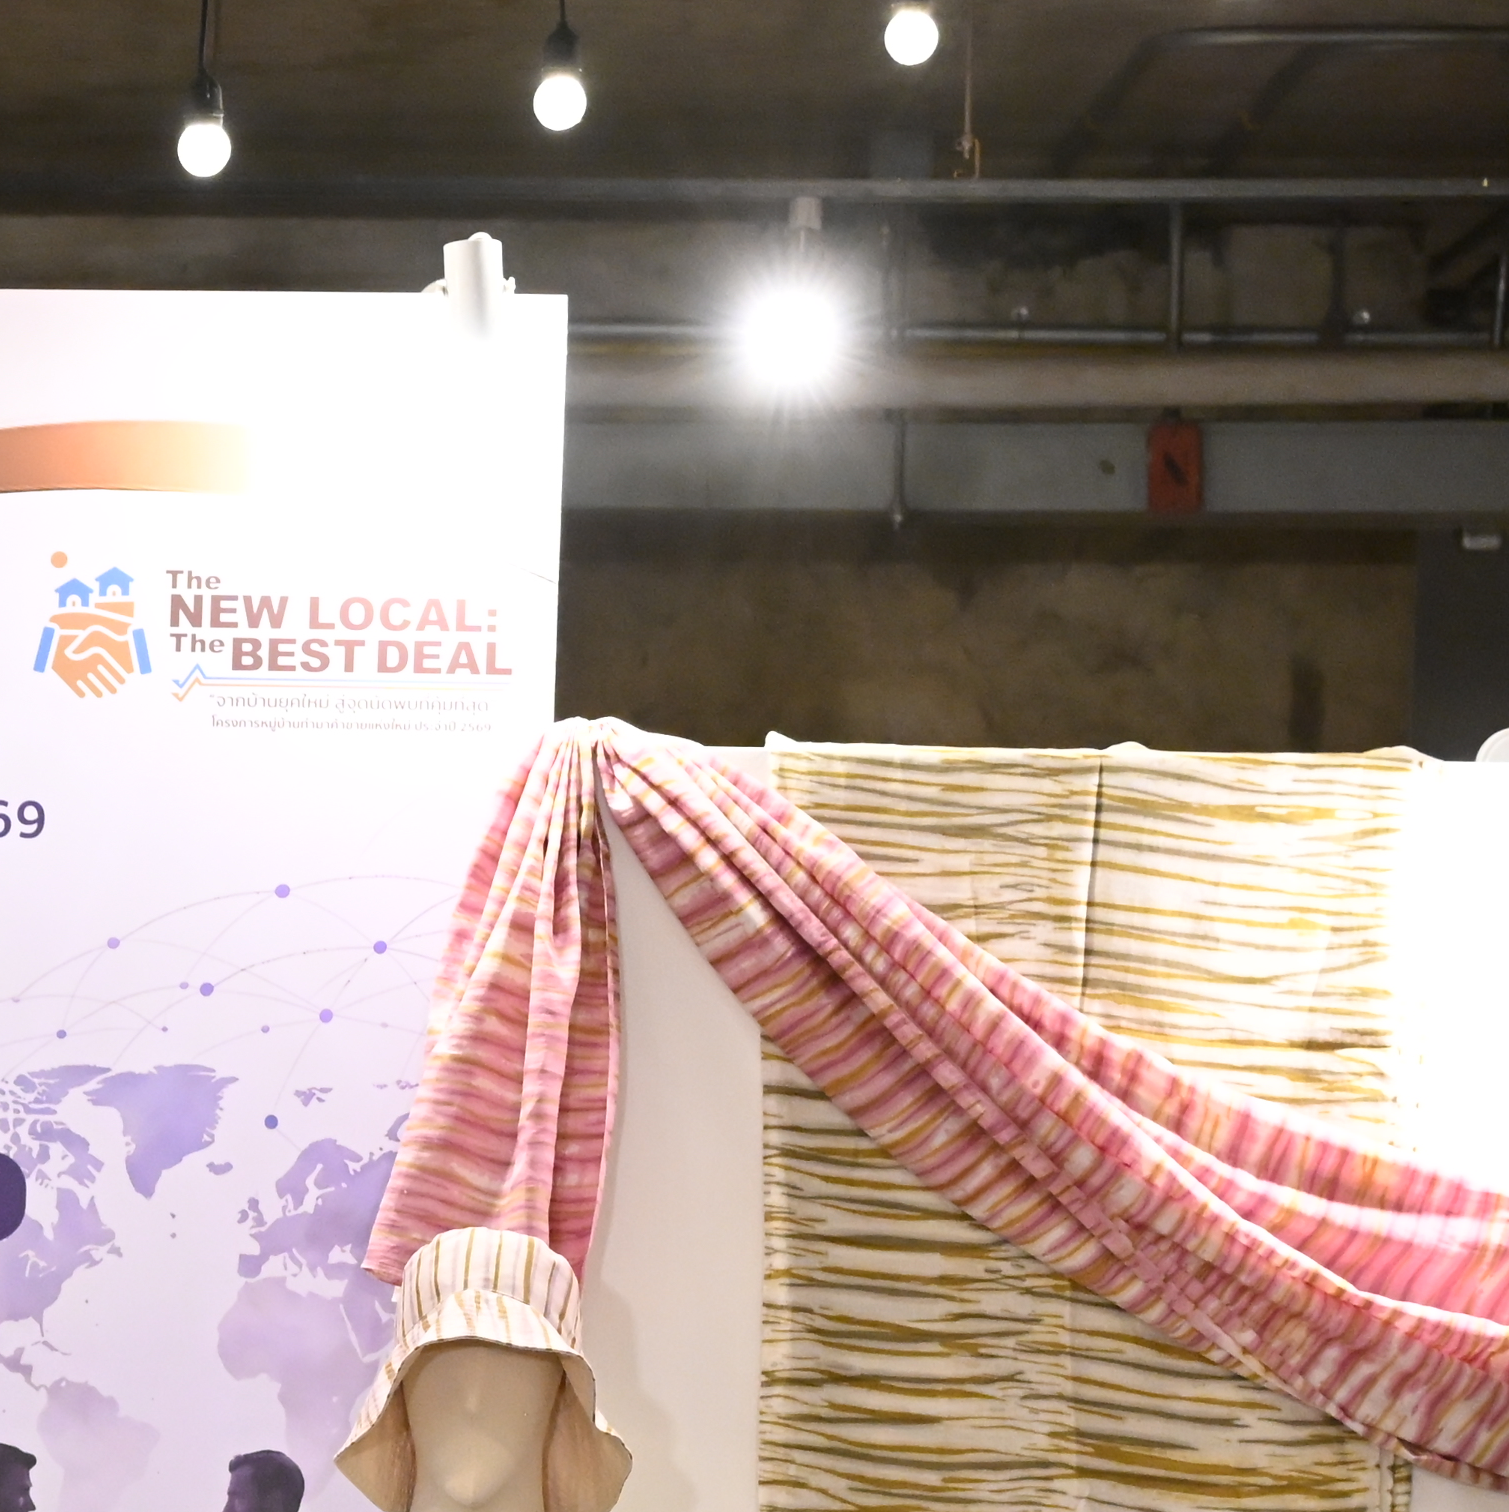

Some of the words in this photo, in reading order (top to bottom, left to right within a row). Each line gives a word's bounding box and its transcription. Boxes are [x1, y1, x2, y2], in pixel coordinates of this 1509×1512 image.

[166, 570, 221, 590] The
[169, 594, 289, 629] NEW
[308, 596, 497, 633] LOCAL:
[169, 633, 225, 654] The
[231, 637, 366, 673] BEST
[377, 639, 513, 676] DEAL
[461, 722, 492, 732] 2569
